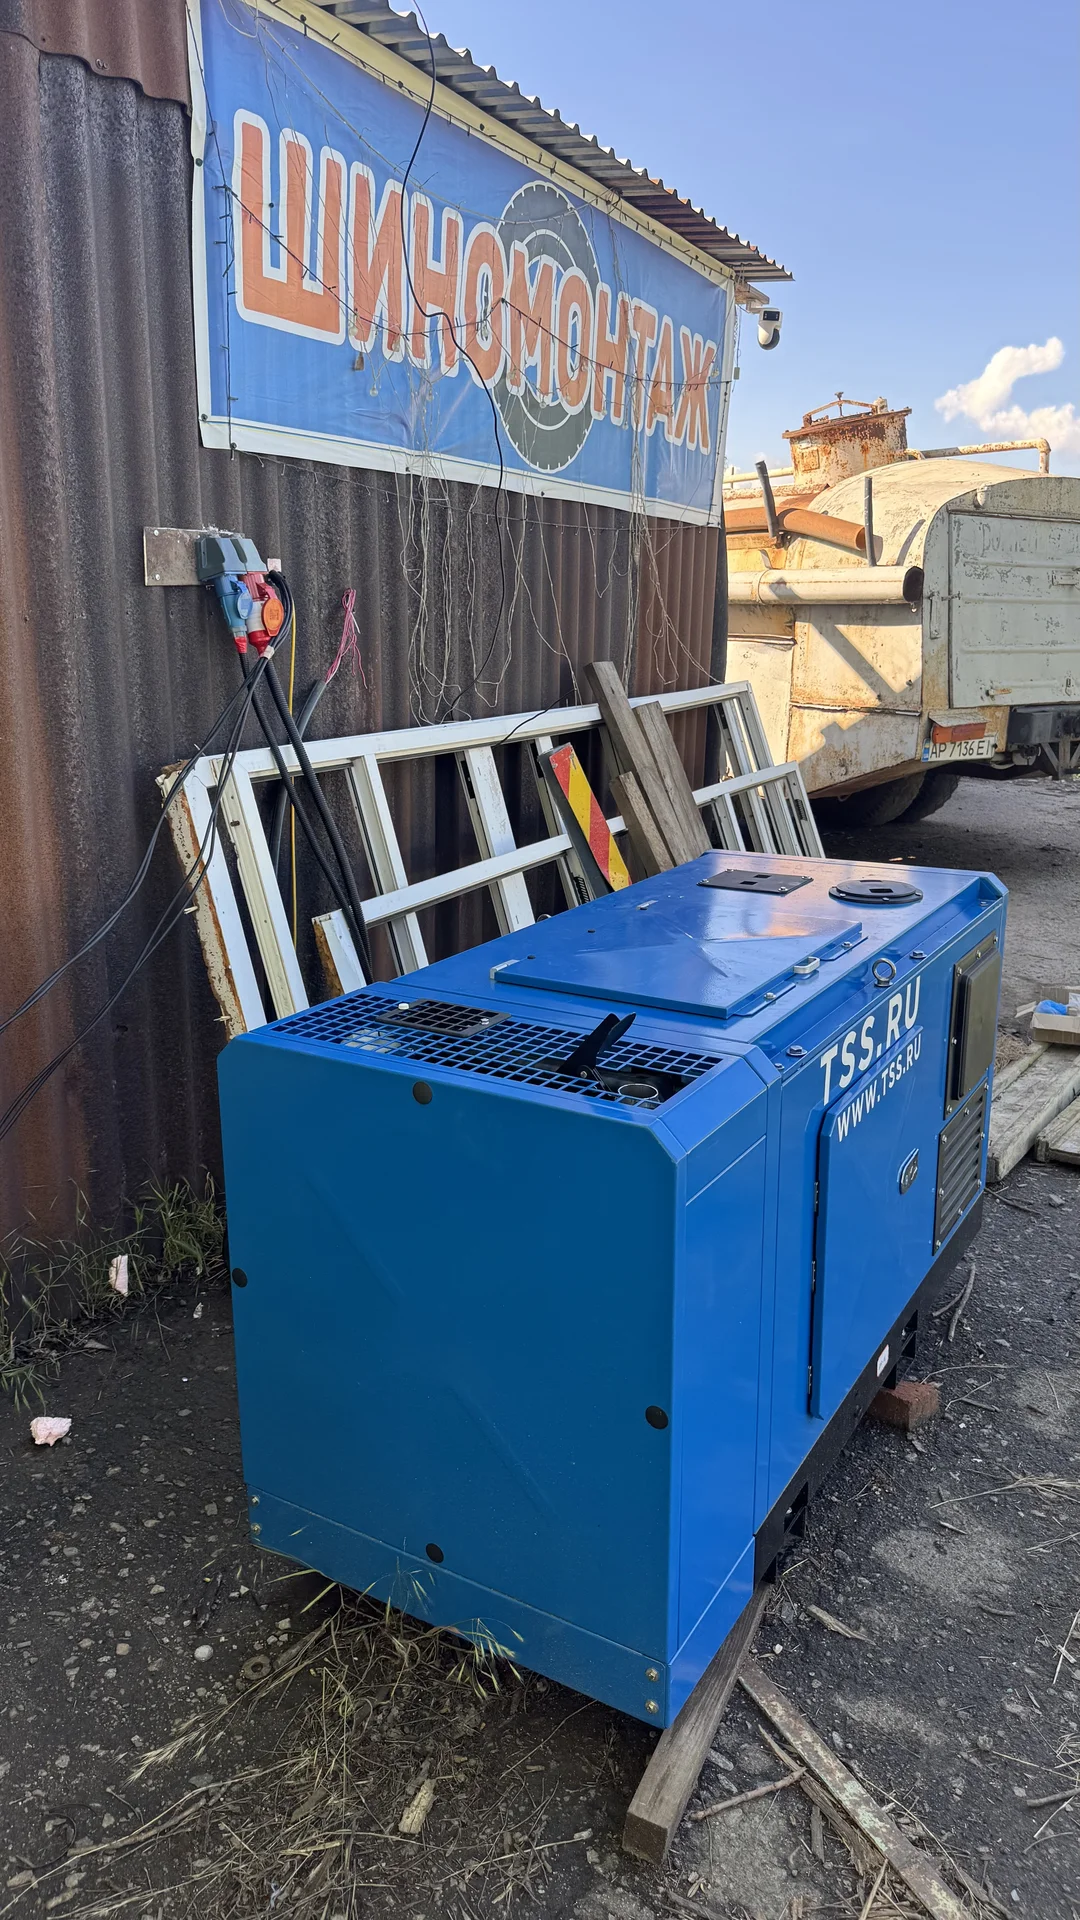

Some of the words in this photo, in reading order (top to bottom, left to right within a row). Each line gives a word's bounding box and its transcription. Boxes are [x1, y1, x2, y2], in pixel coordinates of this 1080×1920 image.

[234, 109, 716, 455] ШИНОМОНТАЖ
[949, 740, 975, 757] 7136
[820, 975, 921, 1106] TSS.RU
[837, 1033, 922, 1142] WWW.TSS.RU
